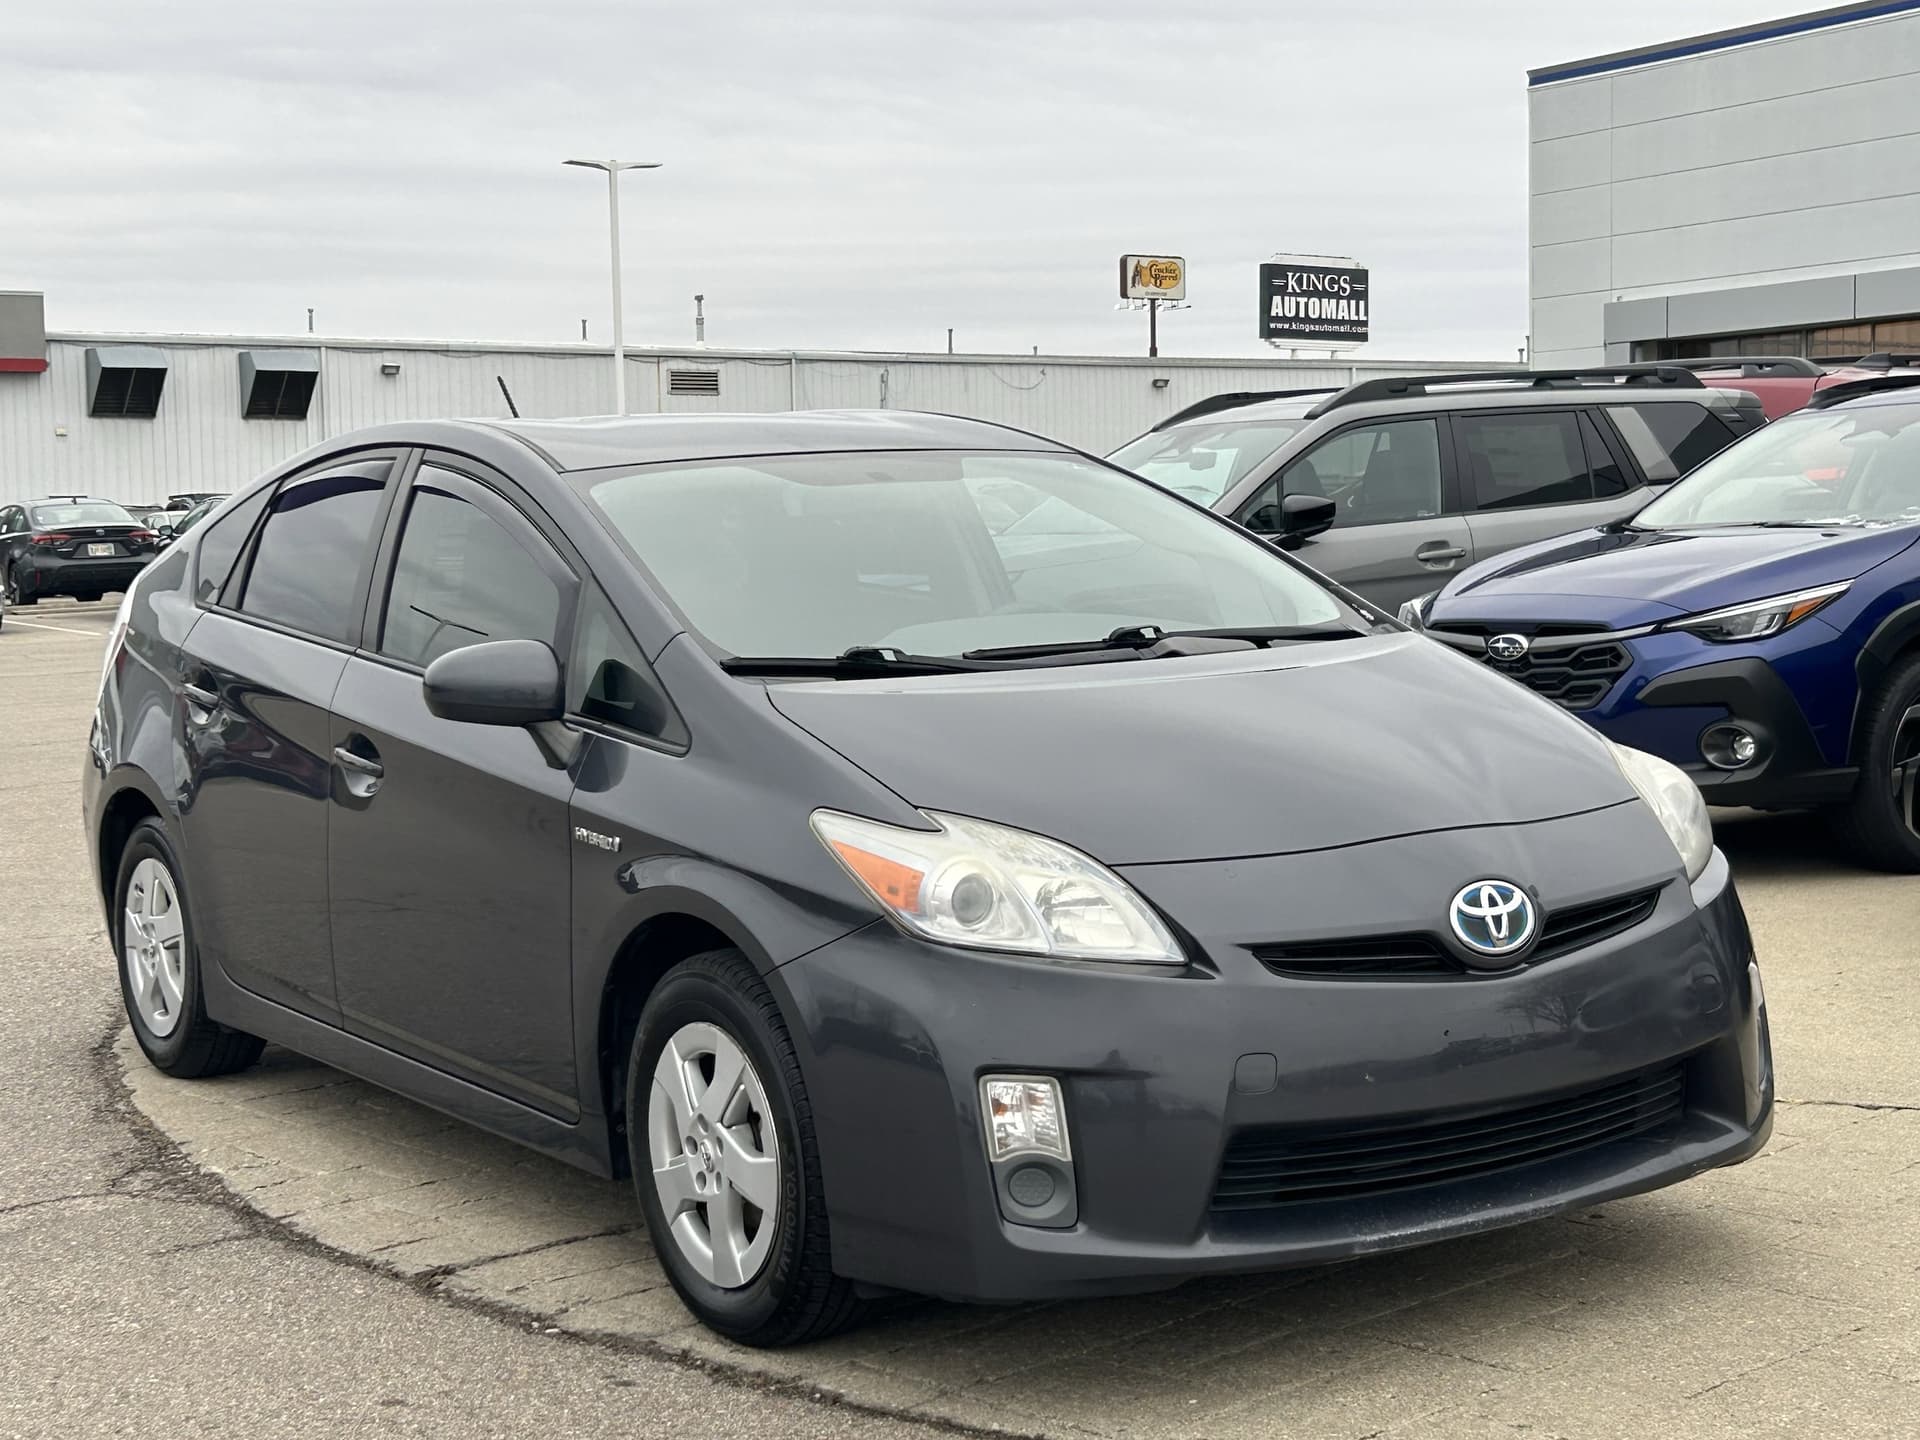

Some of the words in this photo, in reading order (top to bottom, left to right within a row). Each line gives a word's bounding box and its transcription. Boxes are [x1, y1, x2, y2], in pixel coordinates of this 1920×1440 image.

[1149, 263, 1177, 279] Cracker
[1153, 274, 1178, 288] Barrel
[1286, 272, 1351, 297] KINGS
[1270, 295, 1368, 321] AUTOMALL
[1269, 322, 1369, 333] www.kingsautomall.com
[575, 826, 613, 850] HYBRID
